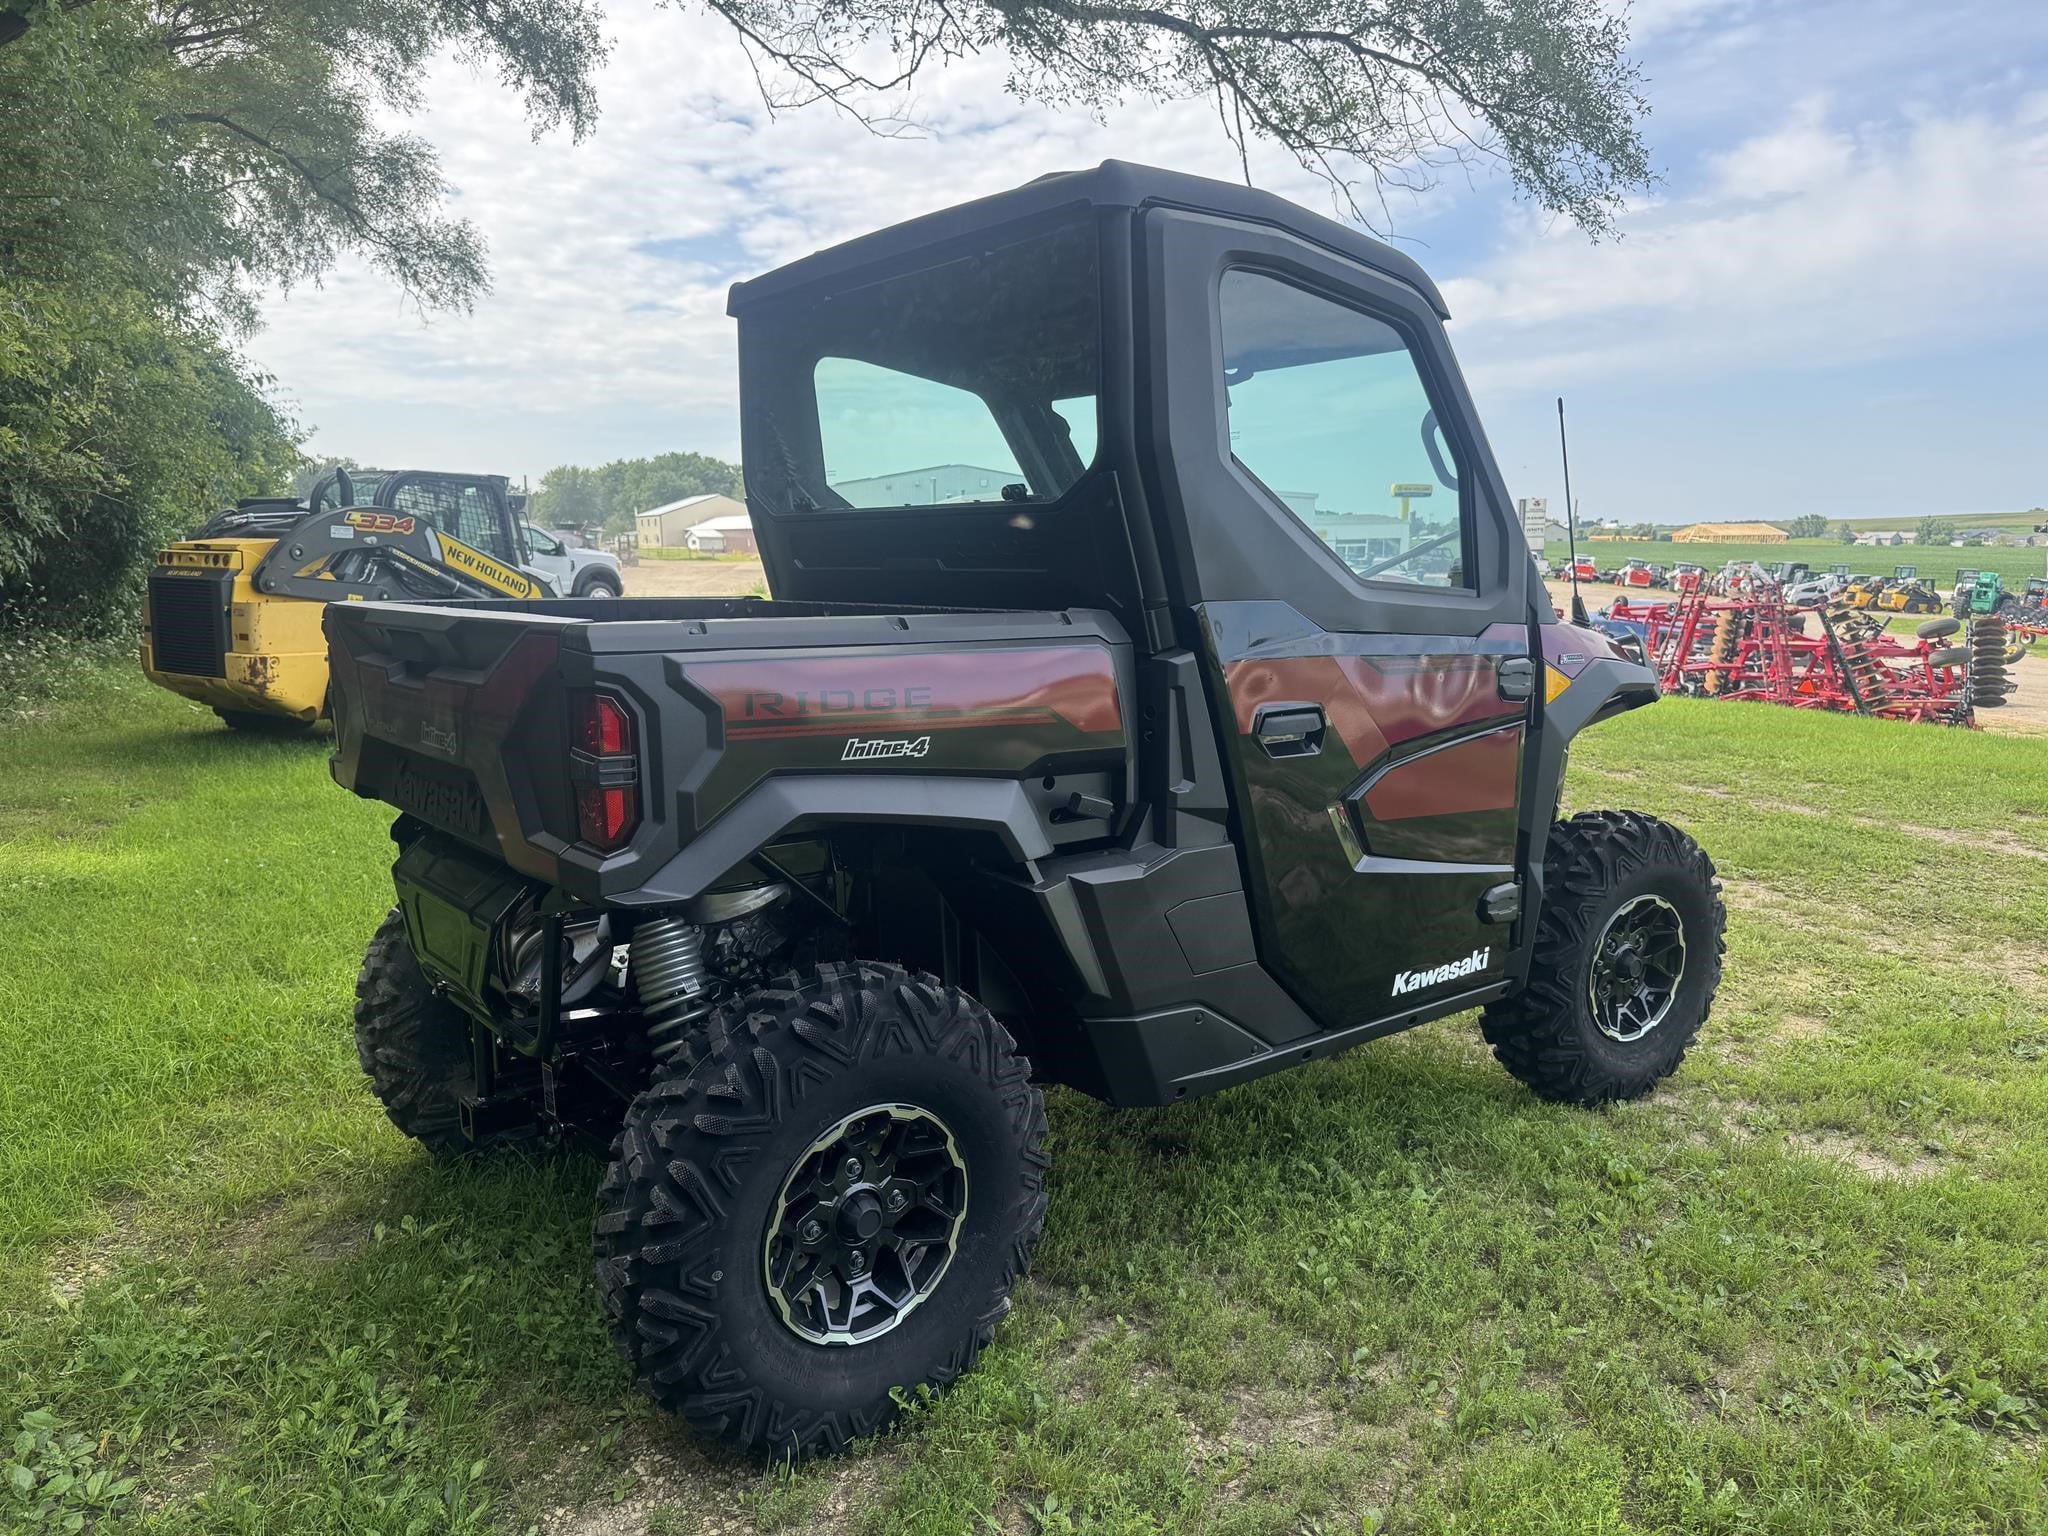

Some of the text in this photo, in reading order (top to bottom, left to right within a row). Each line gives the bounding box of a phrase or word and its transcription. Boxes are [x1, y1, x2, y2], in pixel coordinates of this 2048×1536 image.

[344, 511, 415, 535] L334
[447, 546, 476, 568] NEW
[475, 560, 527, 594] HOLLAND
[744, 686, 932, 718] RIDGE
[419, 720, 457, 755] Inline-4
[840, 735, 931, 761] Inline-4
[392, 757, 482, 835] Kawasaki
[1391, 946, 1490, 997] Kawasaki
